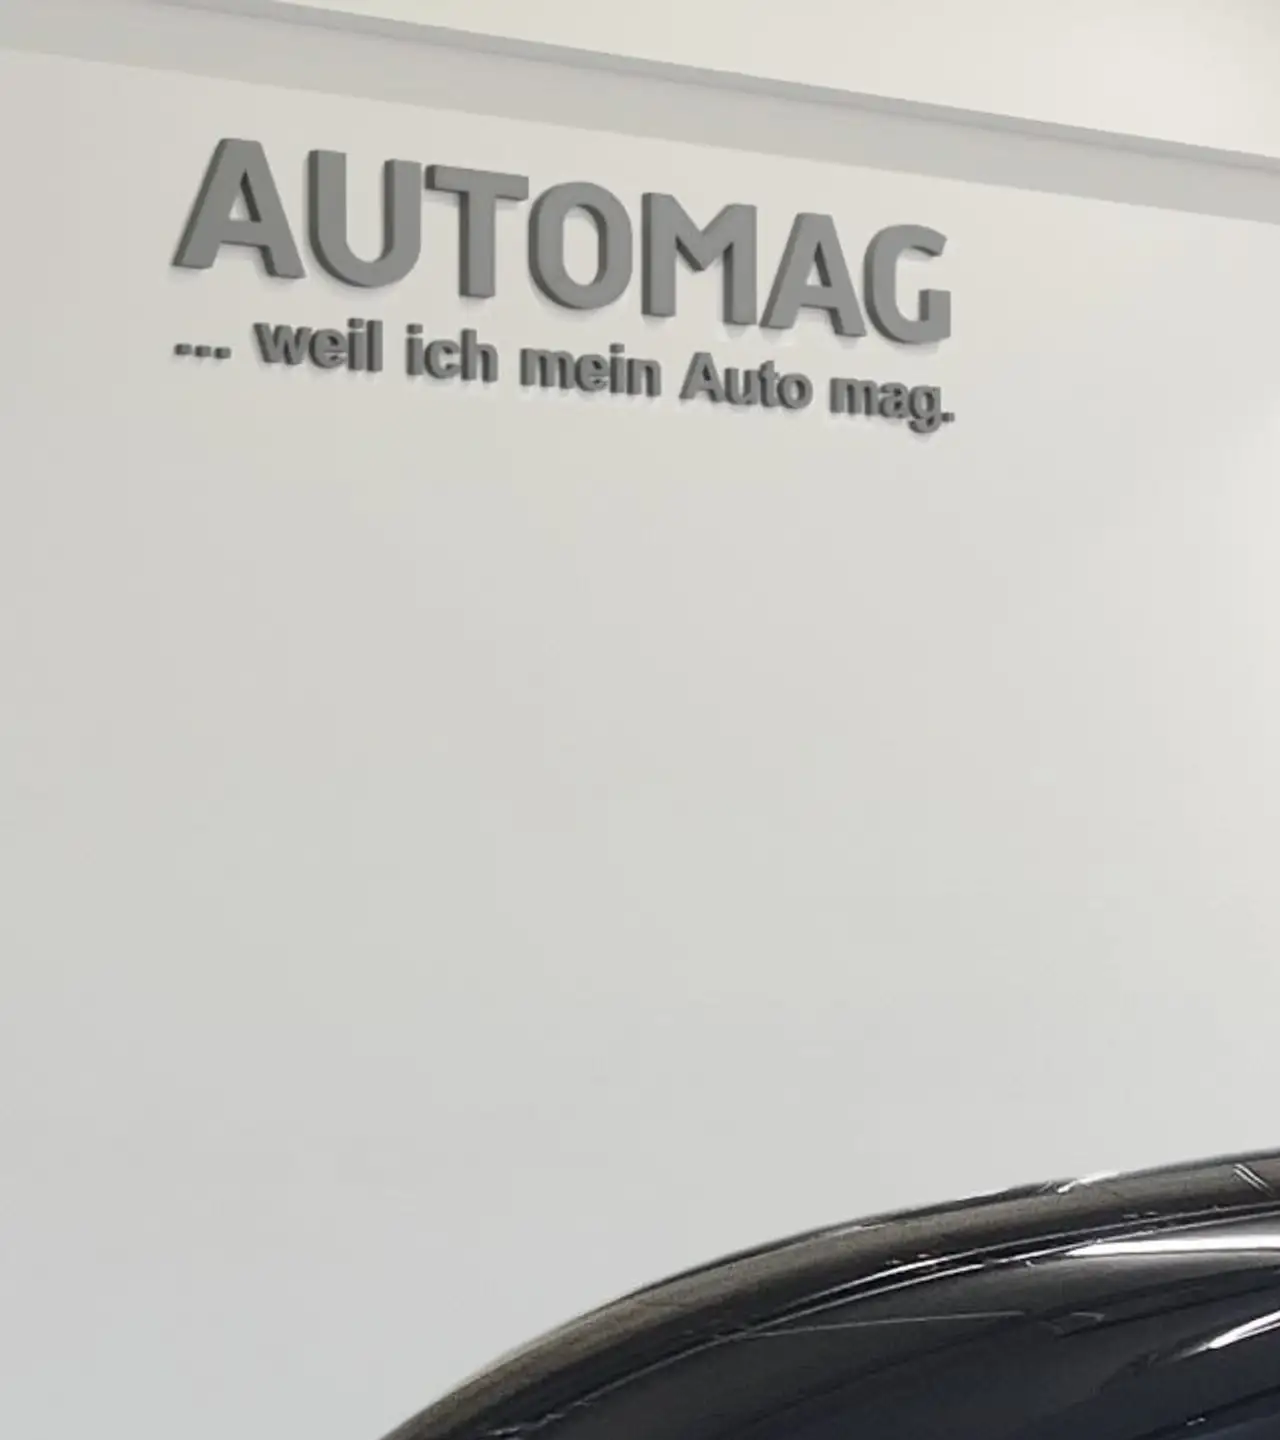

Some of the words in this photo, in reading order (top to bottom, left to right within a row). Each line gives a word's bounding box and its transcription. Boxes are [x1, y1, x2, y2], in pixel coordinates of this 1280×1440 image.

[172, 138, 951, 344] AUTOMAG
[252, 318, 383, 372] weil
[405, 324, 498, 382] ich
[519, 344, 662, 396] mein
[679, 352, 813, 409] Auto
[829, 377, 955, 433] mag.
